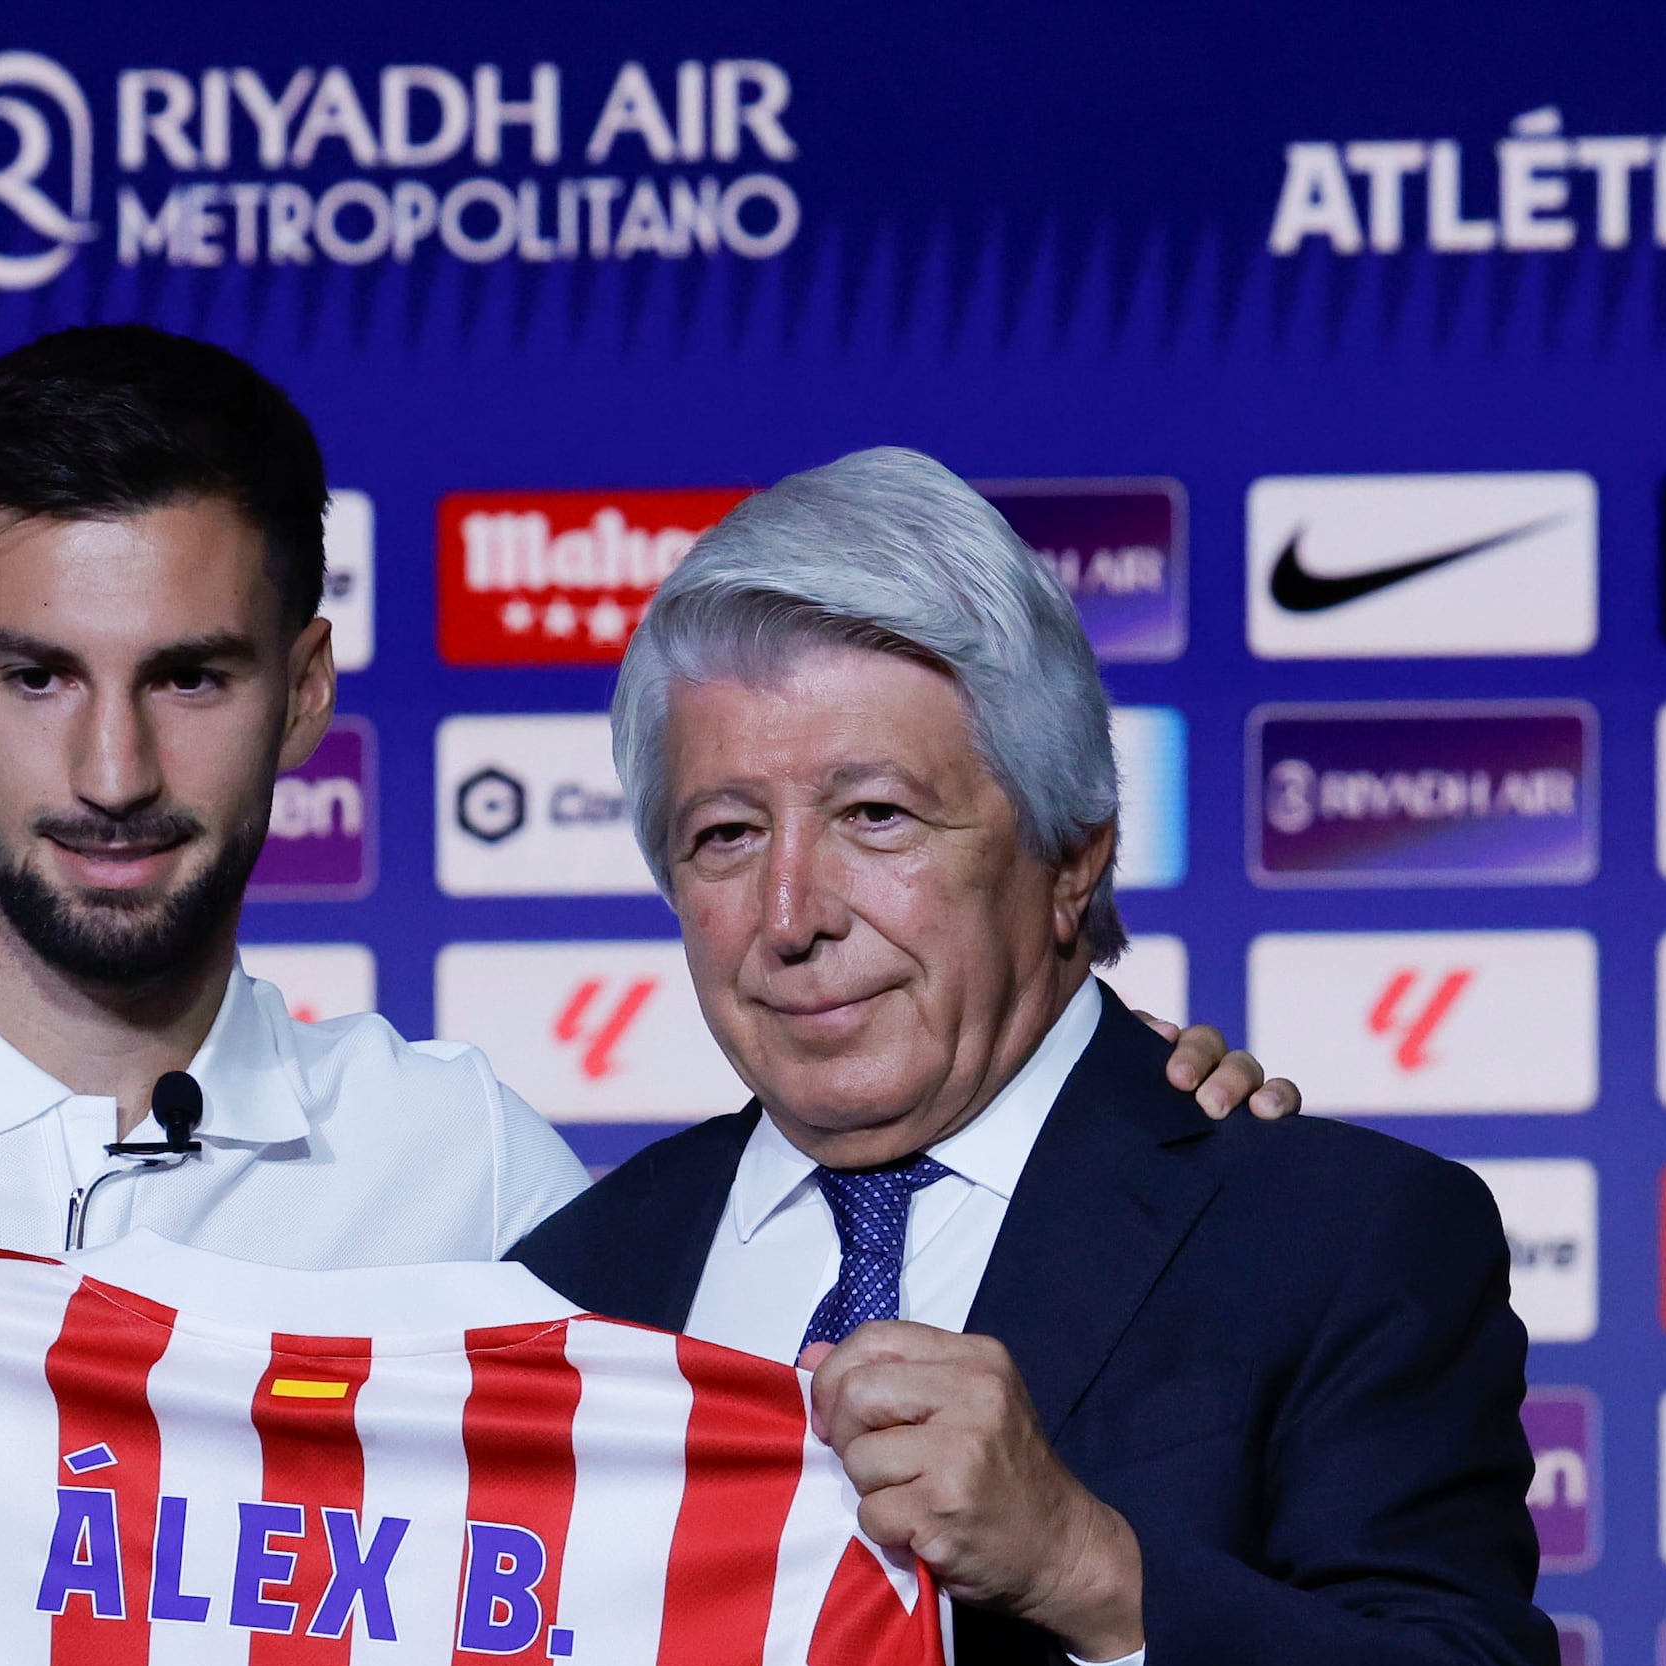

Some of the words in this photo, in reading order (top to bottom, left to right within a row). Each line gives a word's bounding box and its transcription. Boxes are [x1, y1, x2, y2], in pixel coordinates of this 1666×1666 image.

[117, 66, 560, 171] RIYADH
[587, 59, 797, 163] AIR
[117, 173, 799, 268] METROPOLITANO
[462, 509, 699, 591] Maho
[36, 1441, 411, 1643] ÁLEX
[454, 1521, 575, 1658] B.
